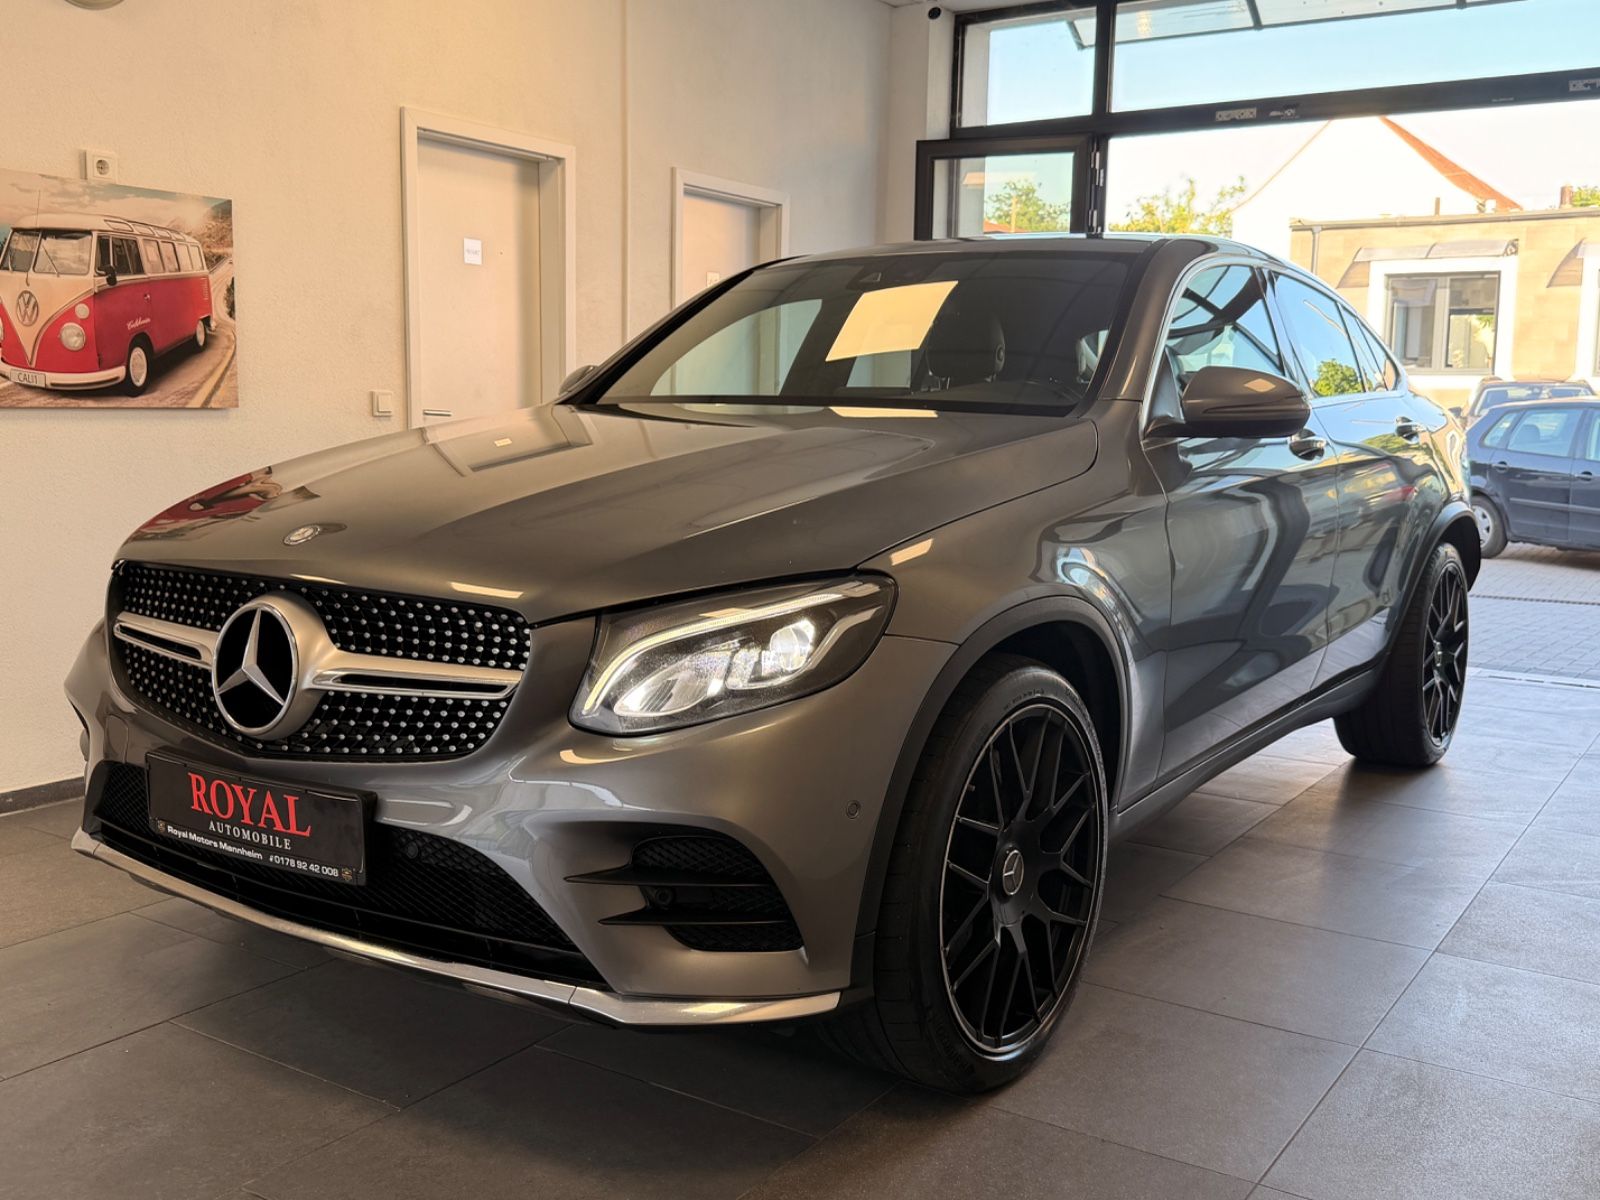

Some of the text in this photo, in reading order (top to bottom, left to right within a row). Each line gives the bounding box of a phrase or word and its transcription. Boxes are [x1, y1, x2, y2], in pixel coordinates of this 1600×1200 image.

[188, 772, 311, 837] ROYAL
[167, 825, 188, 839] Royal
[188, 832, 218, 848] Motors
[219, 841, 263, 860] Mannheim
[296, 860, 308, 871] 92
[309, 864, 321, 874] 42
[321, 866, 339, 877] 008
[209, 820, 292, 850] AUTOMOBILE
